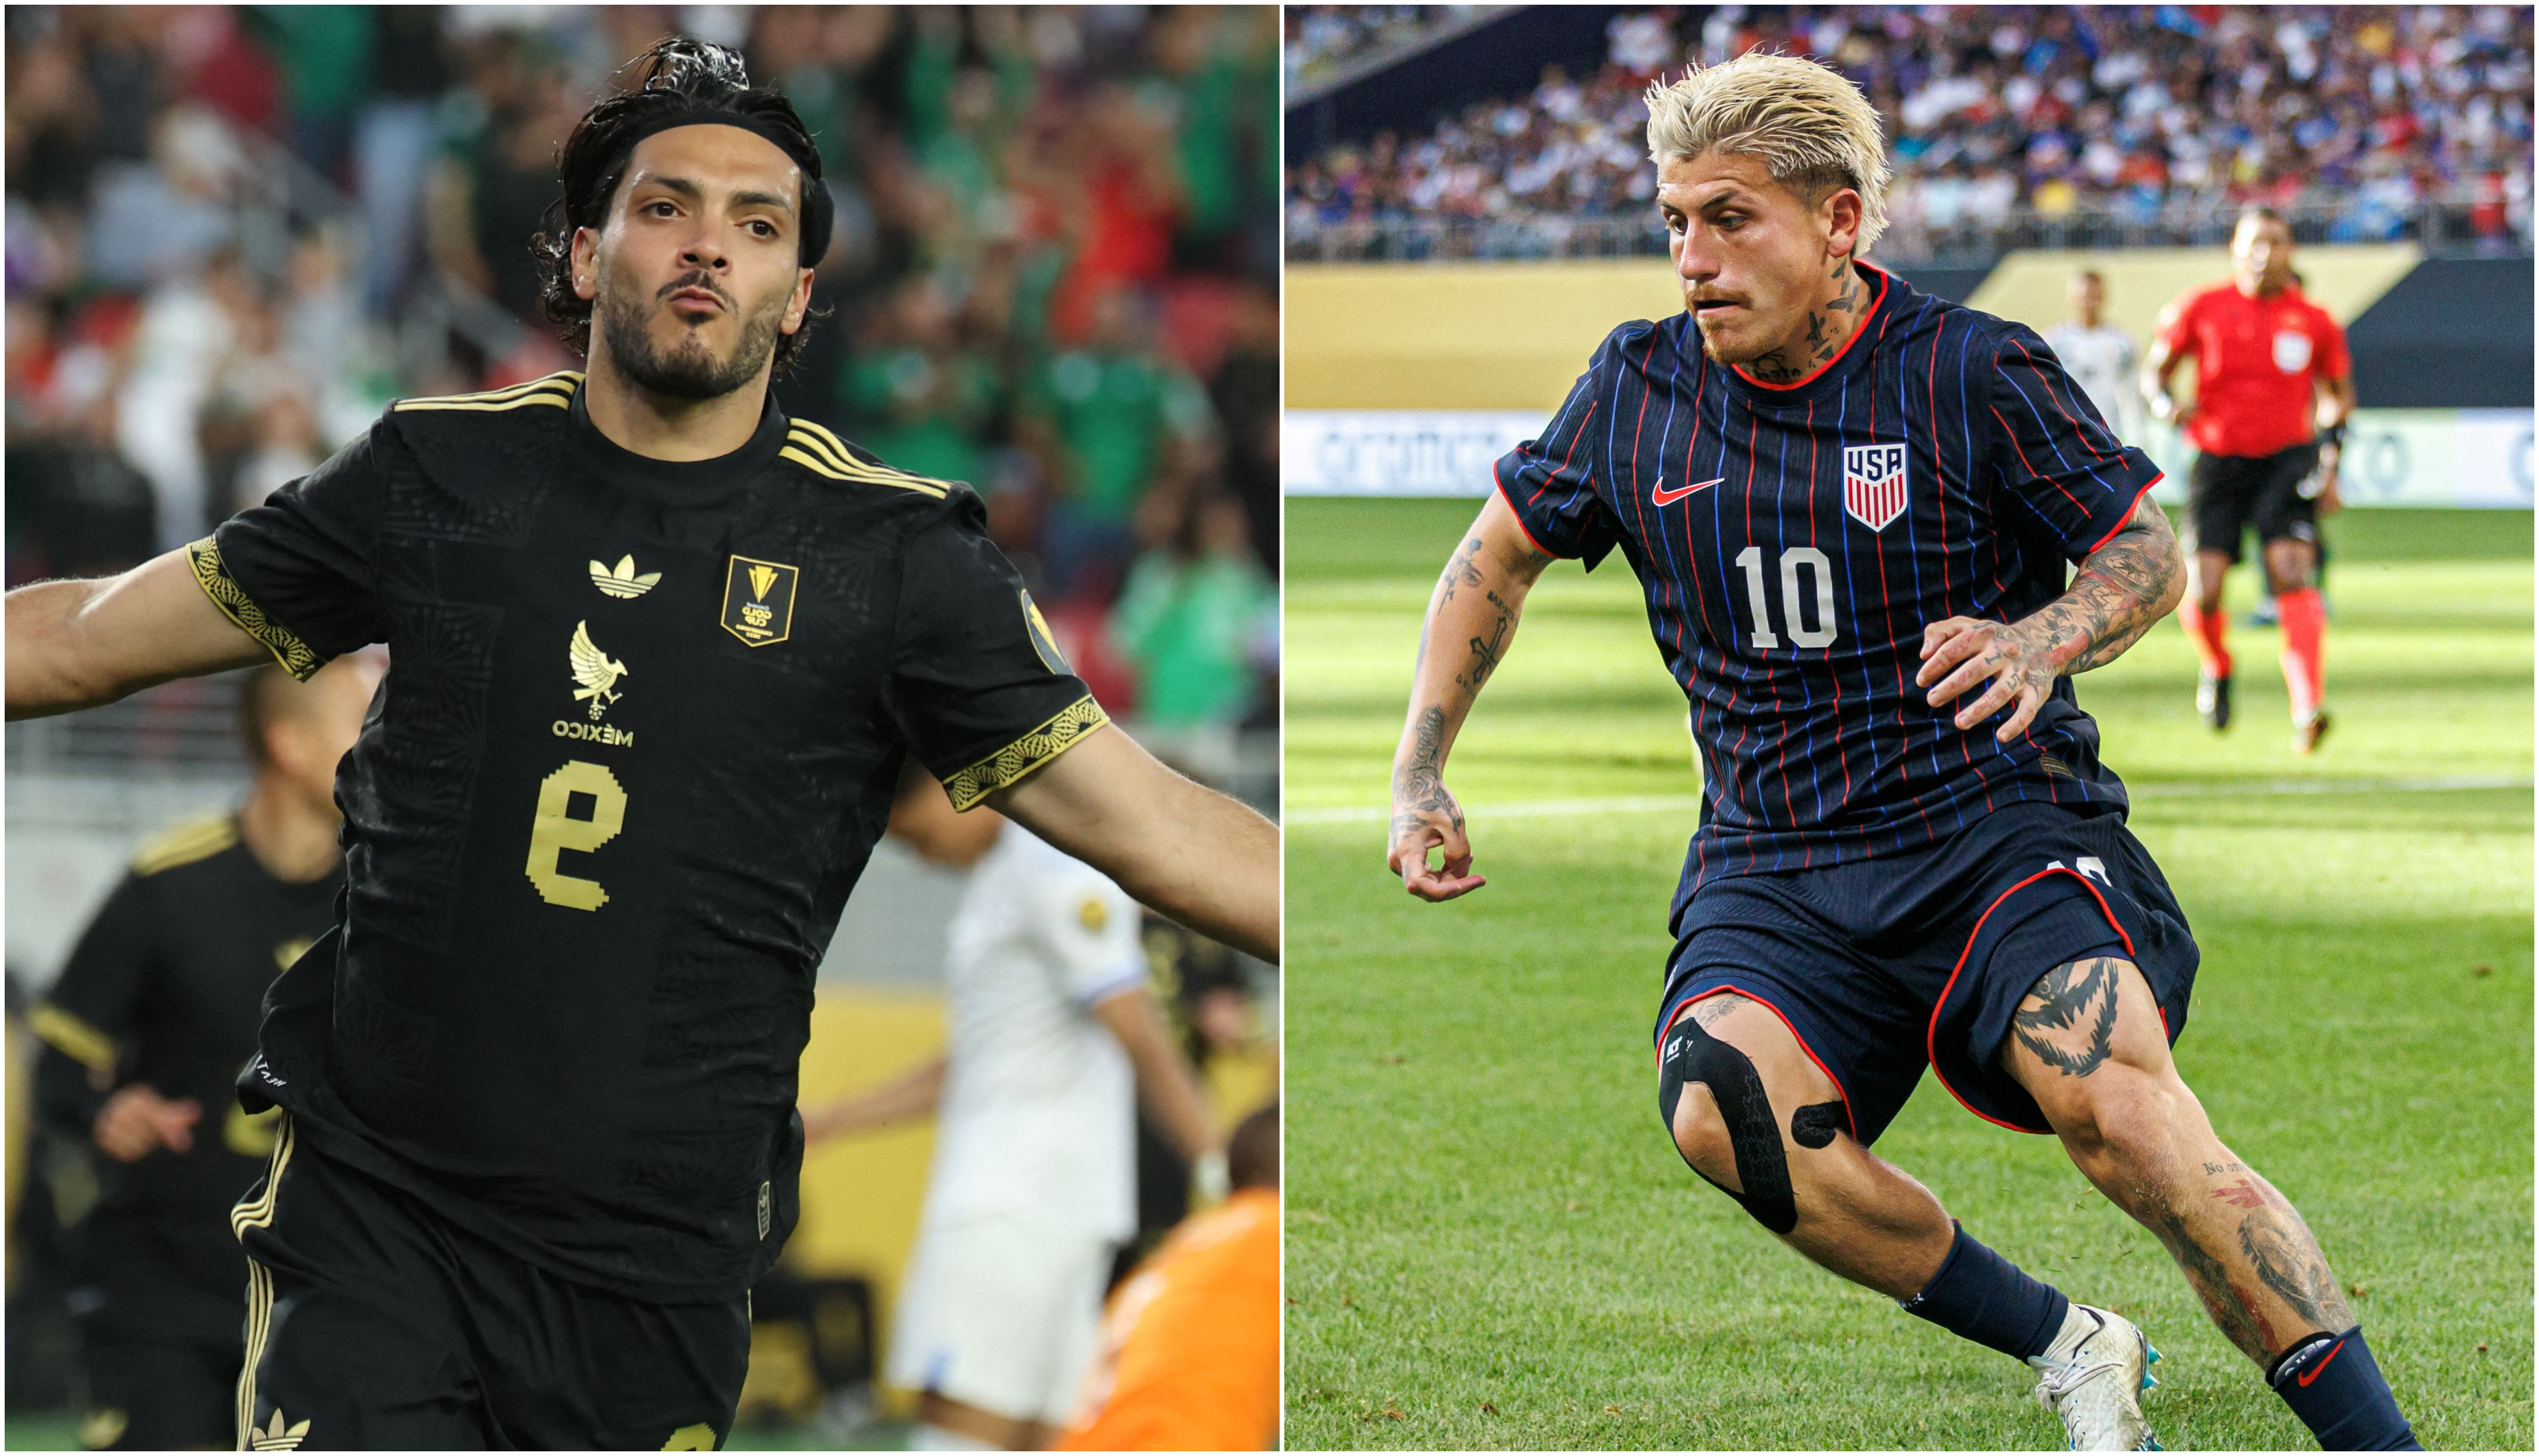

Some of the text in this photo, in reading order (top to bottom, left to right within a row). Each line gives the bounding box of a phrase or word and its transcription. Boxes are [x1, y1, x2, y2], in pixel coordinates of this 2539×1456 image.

[1848, 449, 1903, 481] USA
[1735, 547, 1837, 649] 10
[2202, 1162, 2225, 1176] No
